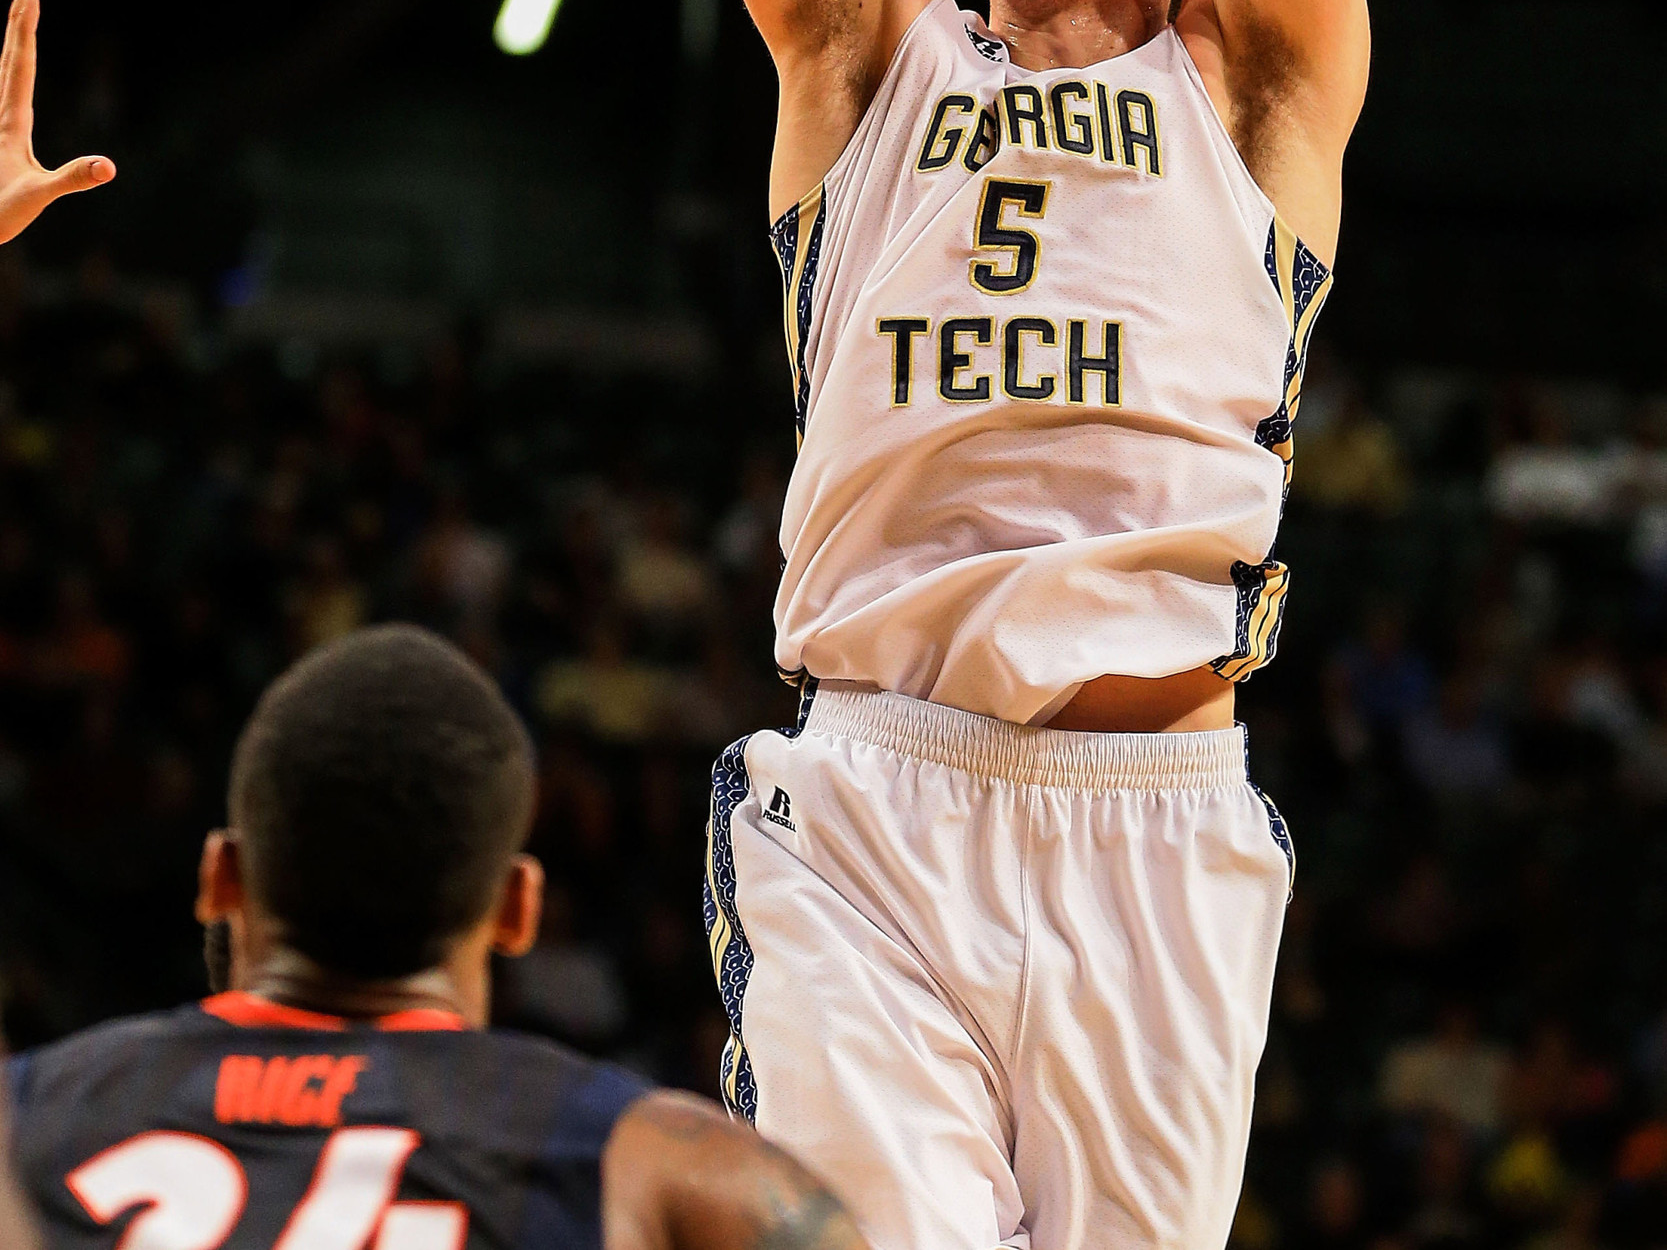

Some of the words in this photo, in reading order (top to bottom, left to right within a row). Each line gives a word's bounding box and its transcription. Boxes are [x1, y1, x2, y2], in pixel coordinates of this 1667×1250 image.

[915, 80, 1163, 178] GERGIA
[970, 175, 1052, 296] 5
[876, 316, 1124, 408] TECH
[763, 809, 797, 833] RUSSELL
